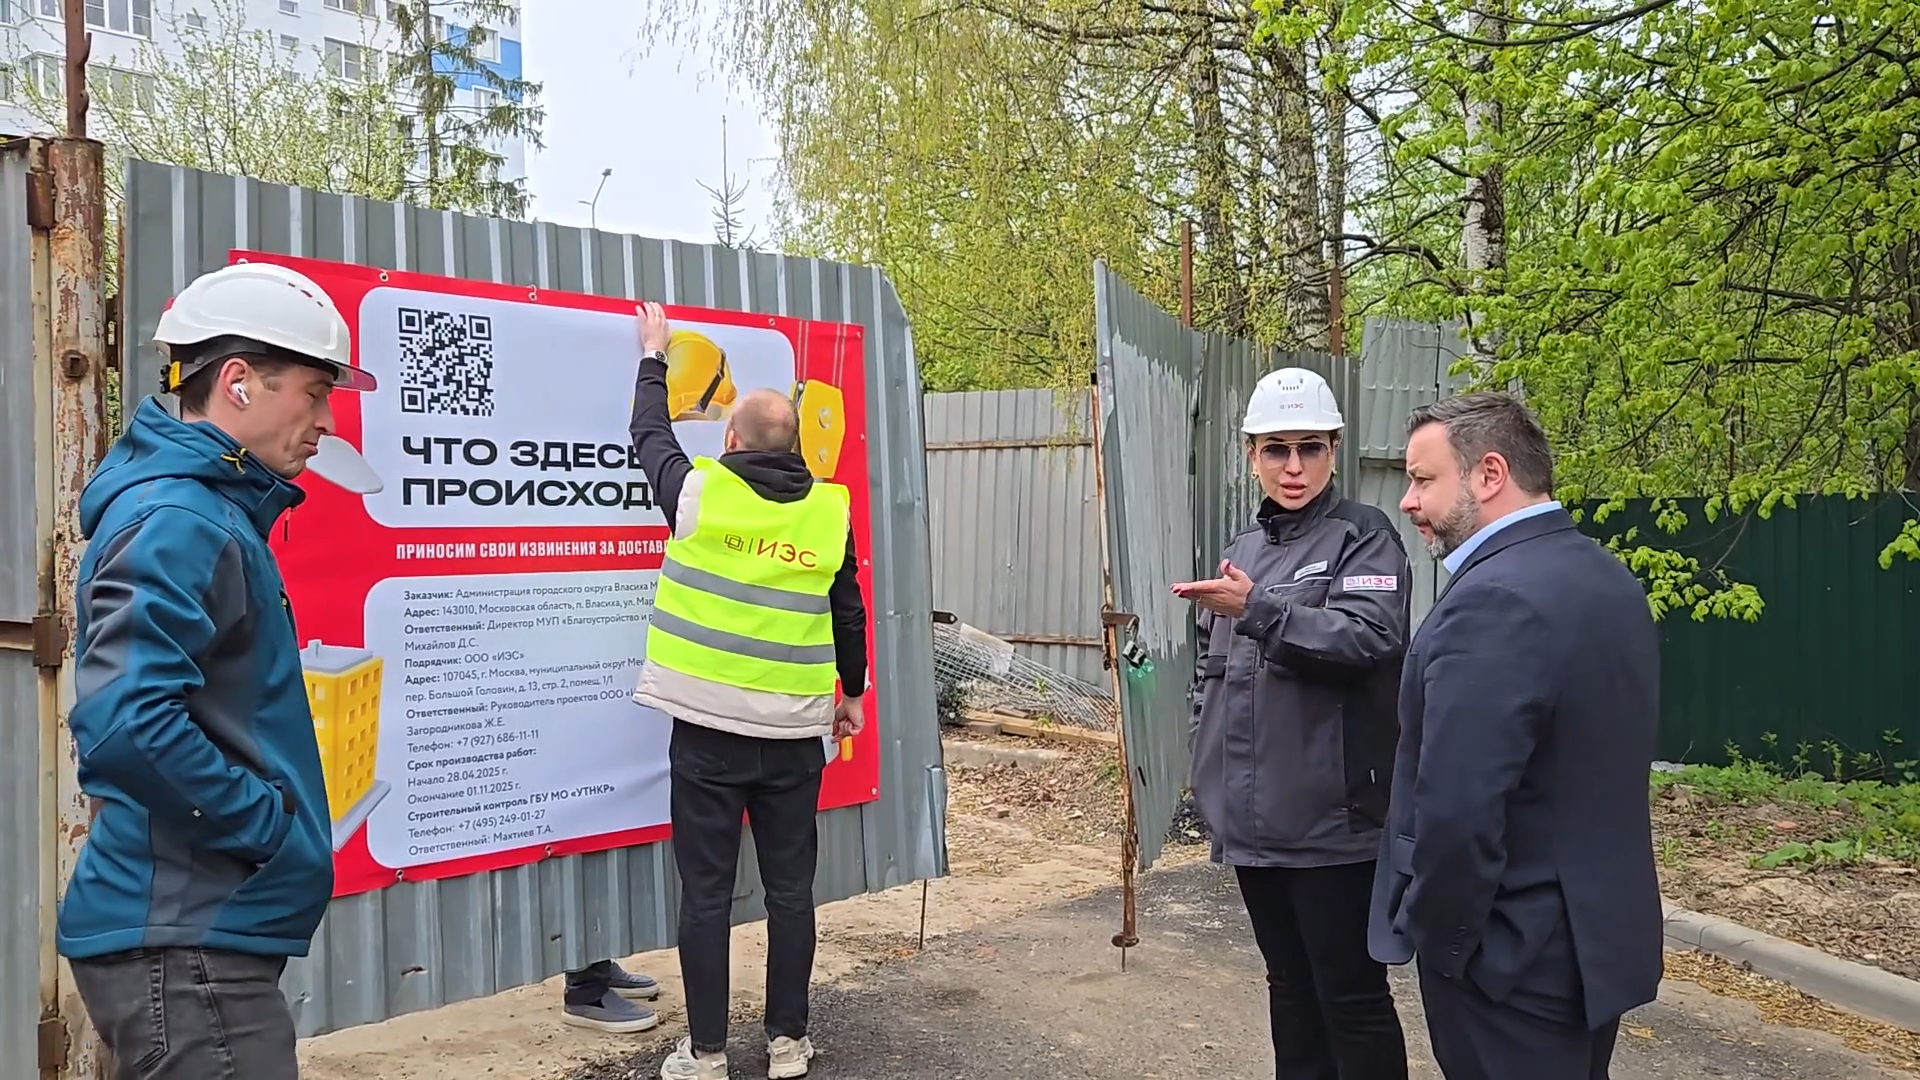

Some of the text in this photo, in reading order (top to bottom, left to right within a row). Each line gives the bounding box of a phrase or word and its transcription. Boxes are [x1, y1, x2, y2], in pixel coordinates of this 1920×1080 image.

[402, 436, 498, 466] ЧТО
[403, 477, 661, 511] ПРОИСХОД
[396, 542, 476, 560] ПРИНОСИМ
[480, 542, 516, 558] СВОИ
[519, 540, 596, 557] ИЗВИНЕНИЯ
[599, 540, 615, 555] ЗА
[757, 538, 817, 568] ИЭС
[403, 590, 454, 601] Заказчик:
[455, 588, 532, 599] Администрация
[532, 585, 581, 597] городского
[584, 584, 613, 594] округа
[614, 582, 648, 592] Власиха
[1362, 577, 1394, 586] ИЭС
[403, 607, 440, 619] Адрес:
[442, 604, 478, 616] 143010,
[479, 603, 536, 614] Московская
[537, 600, 575, 611] область,
[576, 601, 584, 609] п.
[585, 599, 623, 609] Власиха,
[623, 598, 635, 608] ул.
[404, 621, 485, 635] Ответственный:
[487, 619, 534, 631] Директор
[536, 616, 560, 627] МУП
[562, 612, 640, 625] «Благоустройство
[404, 637, 479, 652] Михайлов Д.С.
[404, 651, 525, 669] Подрядчик: ООО «ИЭС»
[404, 674, 441, 686] Адрес:
[443, 670, 480, 682] 107045,
[489, 668, 528, 679] Москва,
[529, 660, 601, 676] муниципальный
[602, 659, 626, 670] округ
[405, 693, 427, 704] пер.
[428, 687, 473, 700] Большой
[475, 685, 517, 696] Головин,
[528, 681, 541, 692] 13,
[541, 681, 559, 691] стр.
[560, 679, 569, 689] 2,
[602, 675, 613, 687] 1/1
[406, 703, 488, 719] Ответственный:
[490, 699, 555, 712] Руководитель
[557, 695, 598, 706] проектов
[600, 689, 624, 700] ООО
[406, 716, 505, 737] Загородникова Ж.Е.
[406, 729, 539, 753] Телефон: +7 (927) 686-11-11
[407, 747, 537, 772] Срок производства работ:
[407, 766, 509, 788] Начало 28.04.2025 г.
[407, 789, 465, 805] Окончание
[466, 781, 514, 797] 01.11.2025
[407, 784, 615, 822] Строительный контроль ГБУ МО «УТНКР»
[408, 809, 546, 839] Телефон: +7 (495) 249-01-27
[408, 824, 554, 856] Ответственный: Махтиев Т.А.
